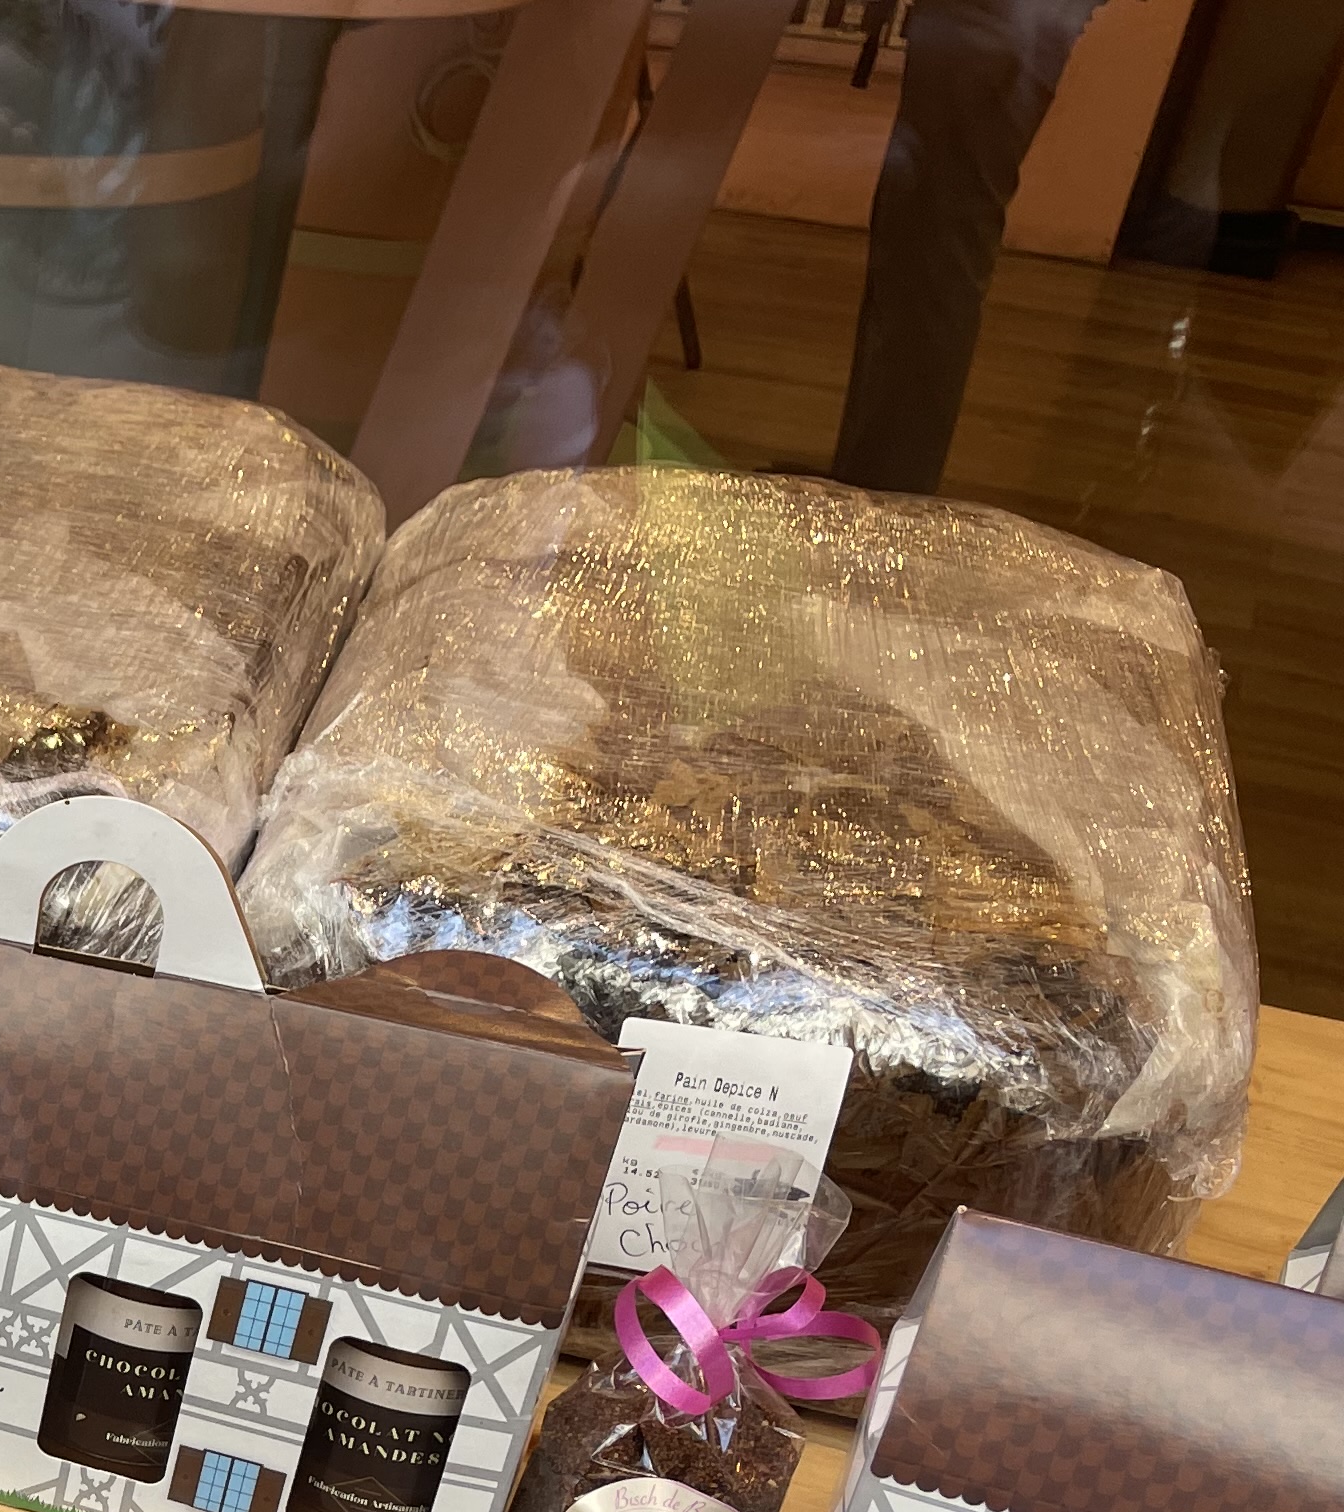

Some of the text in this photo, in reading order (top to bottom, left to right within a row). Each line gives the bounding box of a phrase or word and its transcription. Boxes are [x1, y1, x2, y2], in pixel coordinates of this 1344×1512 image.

[674, 1072, 780, 1102] Pain Depice N
[622, 1156, 638, 1168] kg
[318, 1398, 421, 1444] OCOLAT
[325, 1427, 441, 1466] AMANDES
[614, 1484, 658, 1510] Bisch
[663, 1490, 681, 1511] de
